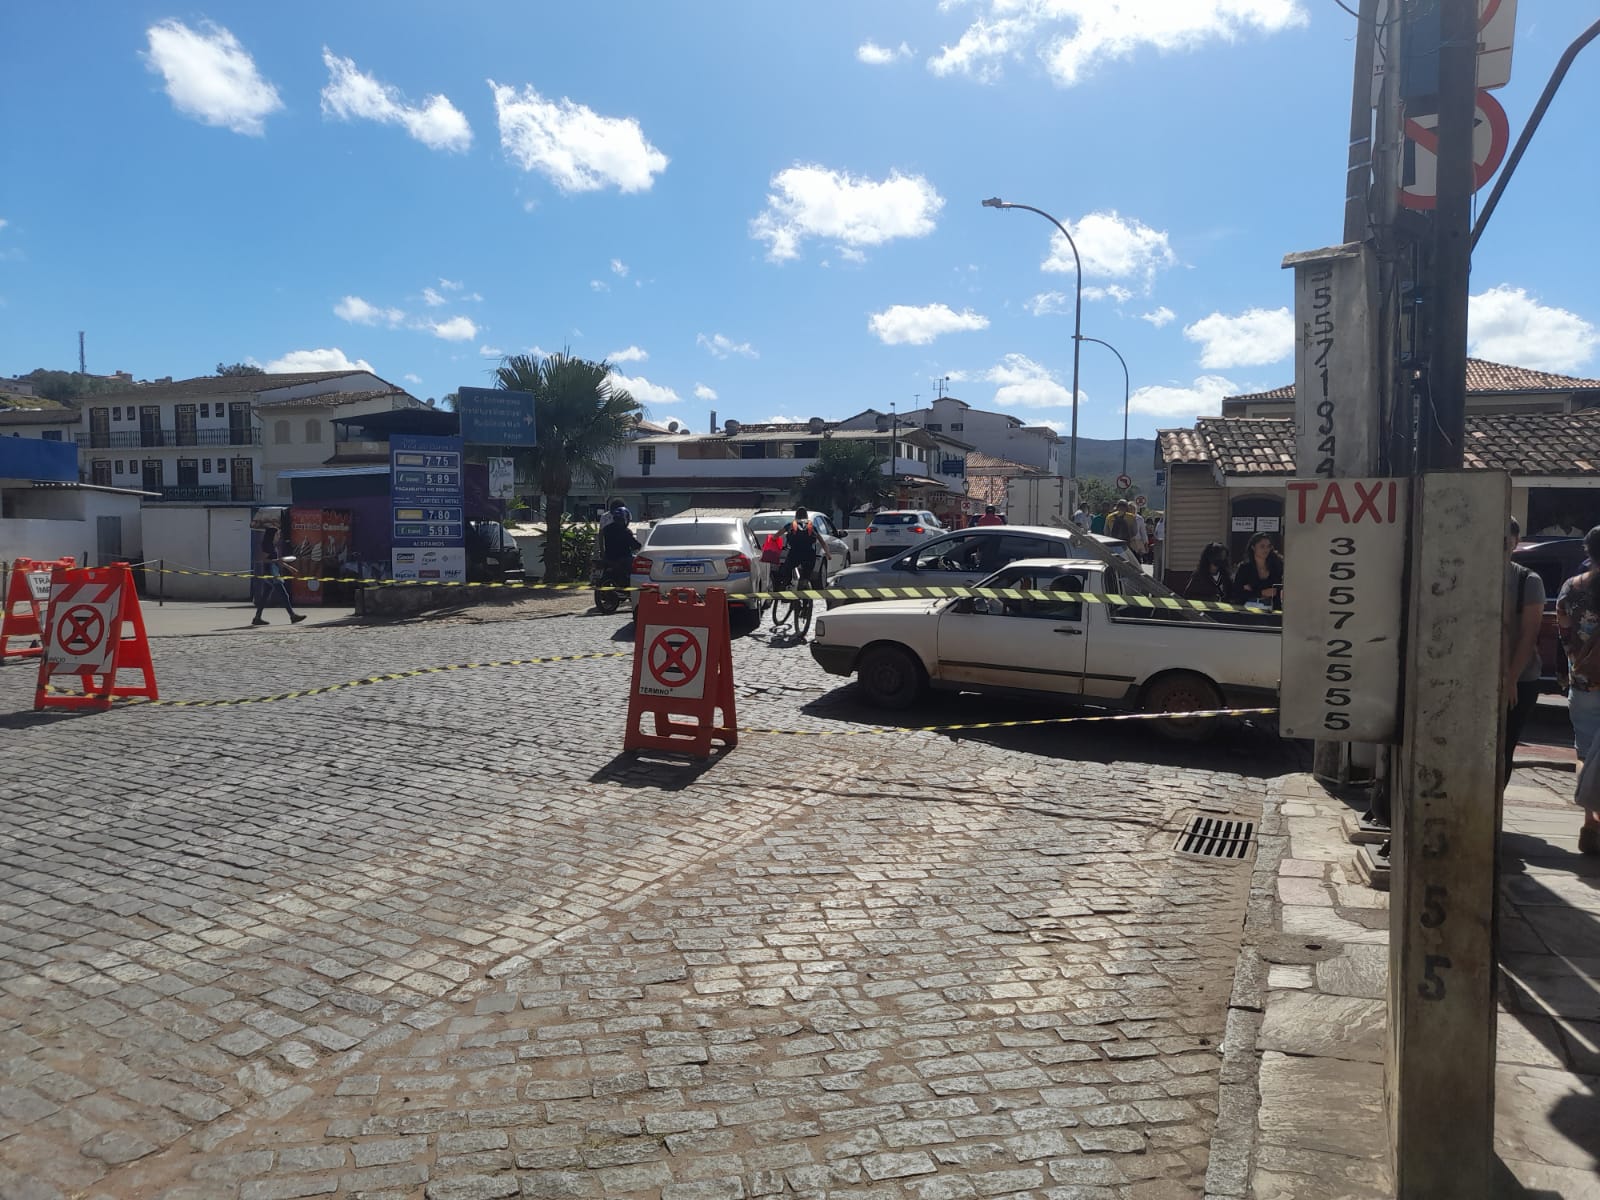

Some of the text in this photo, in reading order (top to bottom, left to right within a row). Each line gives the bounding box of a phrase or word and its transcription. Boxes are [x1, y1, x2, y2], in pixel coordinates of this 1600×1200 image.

[1288, 481, 1397, 524] TAXI
[429, 511, 450, 520] 7.80
[32, 576, 50, 584] TRÂ
